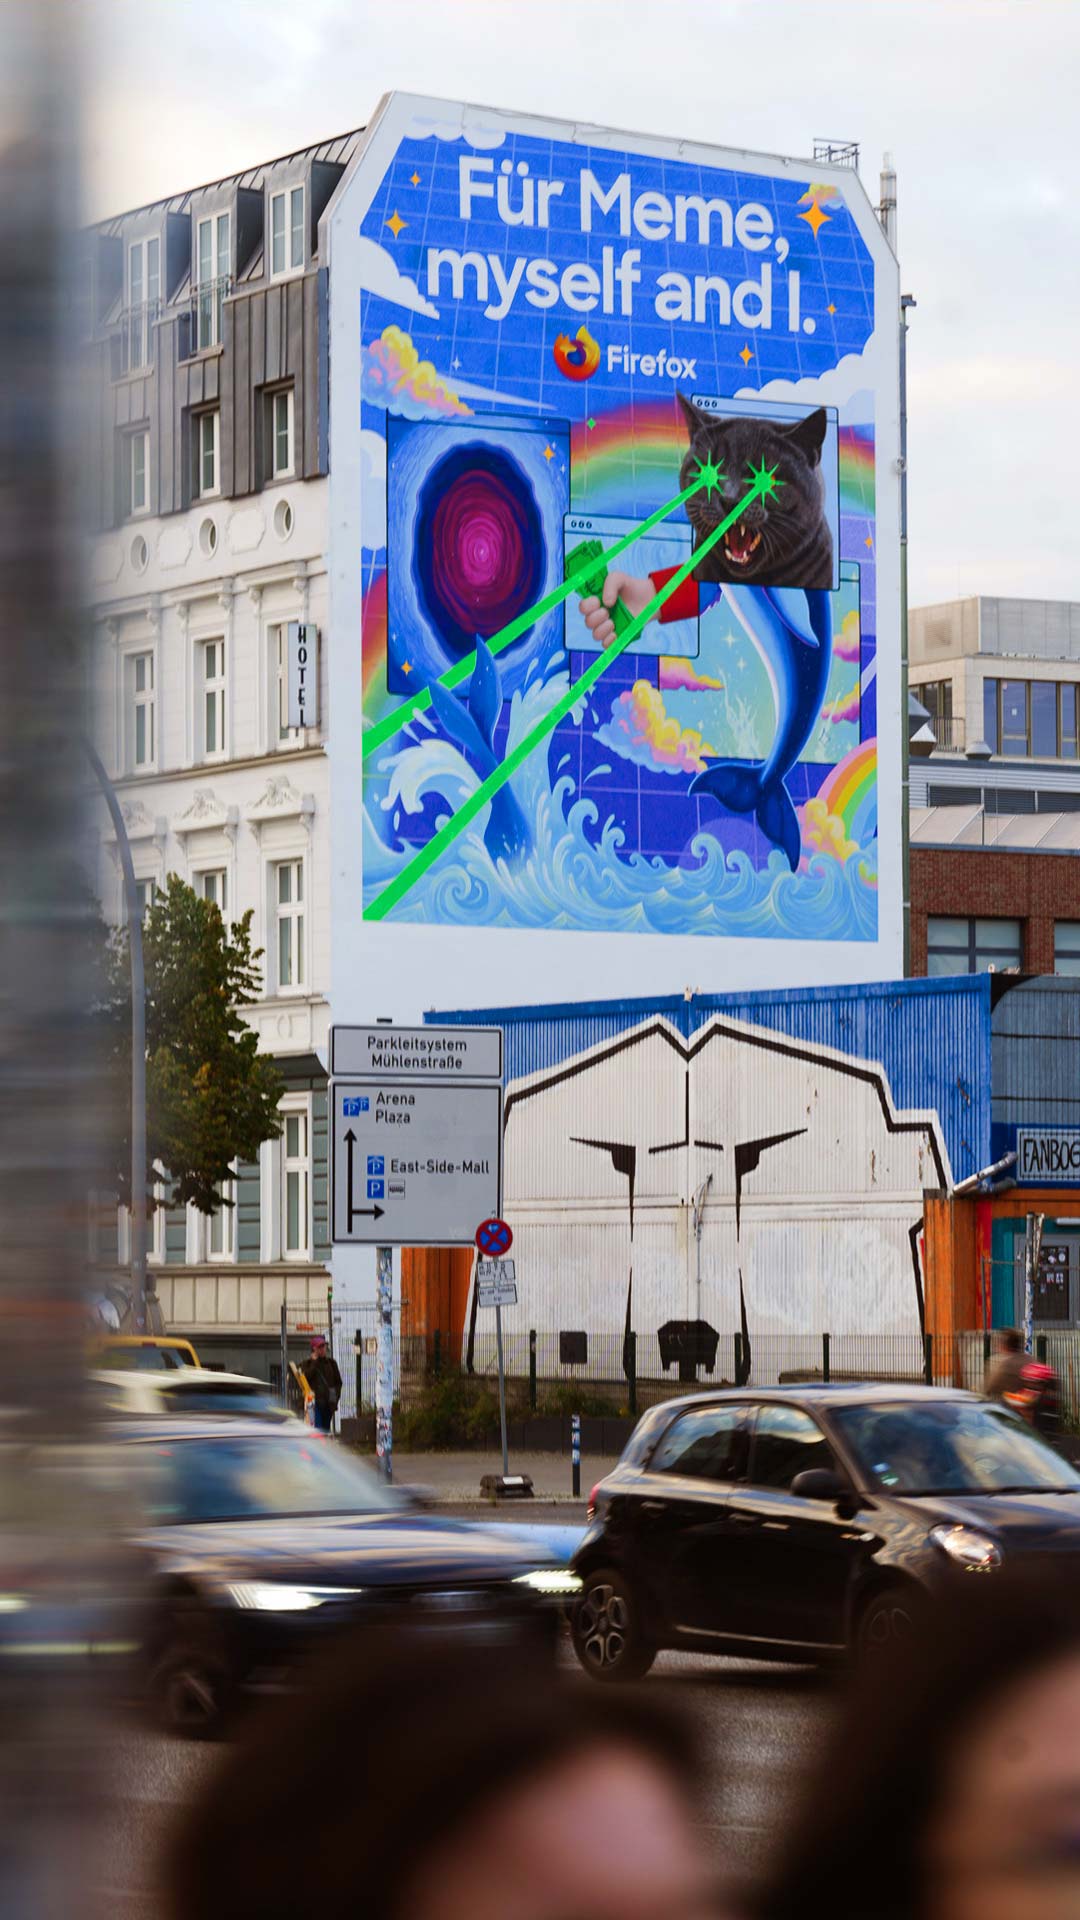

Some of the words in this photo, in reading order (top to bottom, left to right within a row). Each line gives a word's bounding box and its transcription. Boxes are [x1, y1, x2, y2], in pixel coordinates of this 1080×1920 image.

[457, 154, 564, 228] Für
[580, 169, 790, 264] Meme,
[427, 246, 641, 321] myself
[654, 263, 772, 331] and
[788, 268, 816, 335] I.
[606, 344, 697, 380] Firefox
[297, 625, 307, 727] HOTEL
[367, 1035, 467, 1053] Parkleitsystem
[371, 1053, 463, 1069] Mühlenstraße
[376, 1091, 415, 1106] Arena
[375, 1109, 411, 1124] Plaza
[390, 1158, 490, 1175] East-Side-Mall
